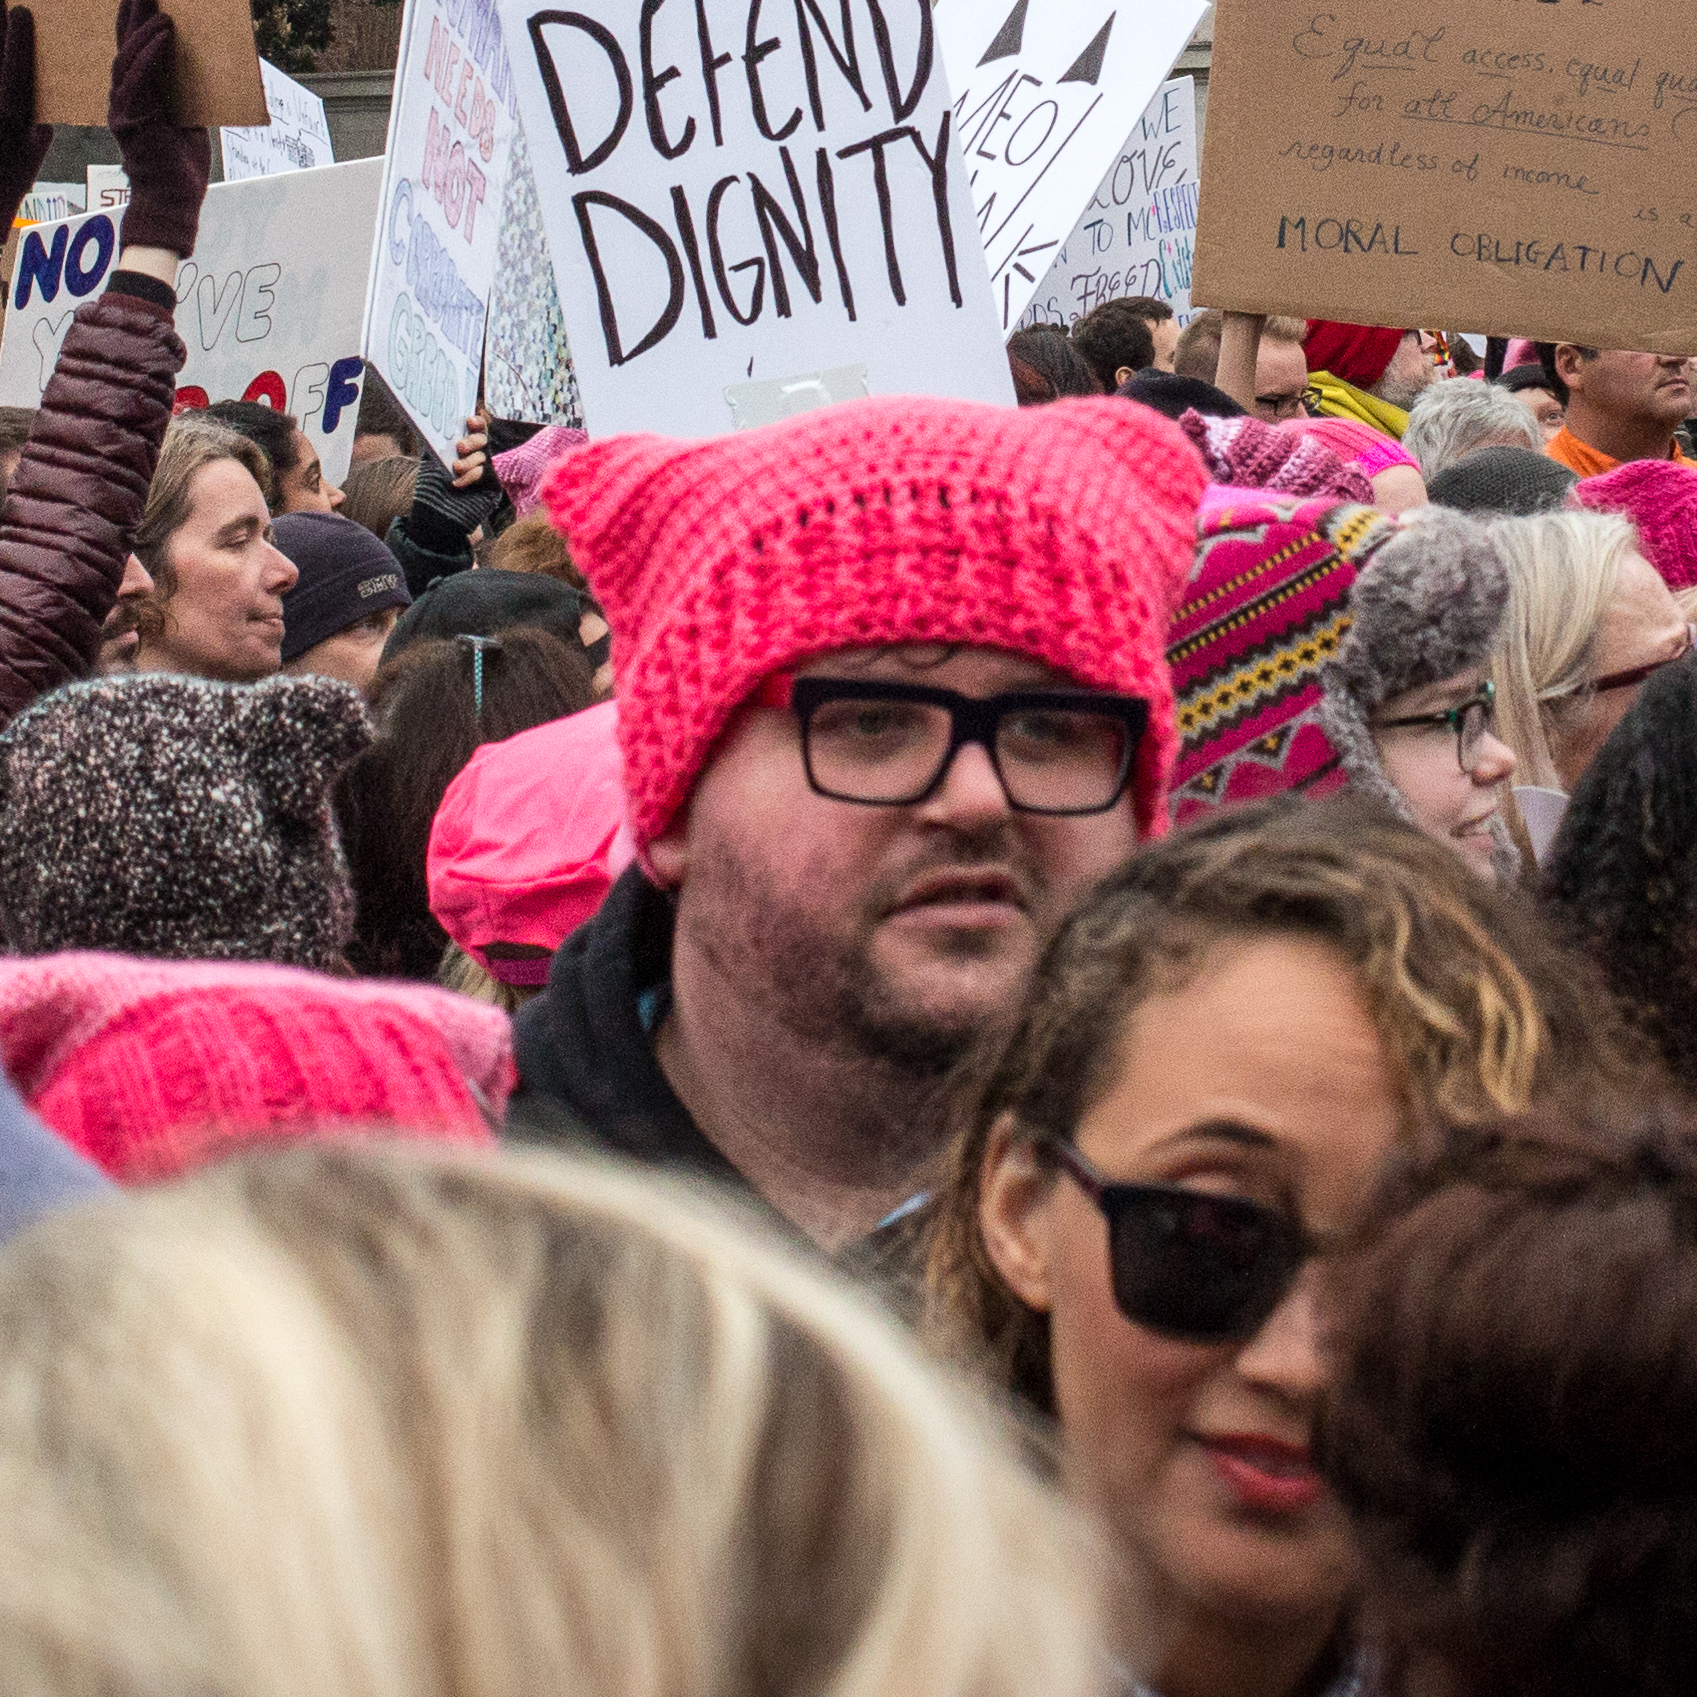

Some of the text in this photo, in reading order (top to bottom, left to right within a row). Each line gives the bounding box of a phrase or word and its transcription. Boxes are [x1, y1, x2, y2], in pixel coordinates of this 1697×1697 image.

[423, 15, 496, 162] NEEDS
[1292, 14, 1446, 83] Equal
[1565, 58, 1640, 96] equal
[1142, 87, 1181, 141] WE
[1404, 91, 1456, 119] all
[1472, 90, 1651, 139] Americans
[421, 105, 486, 245] NOT
[1278, 140, 1600, 195] regardless of income
[571, 110, 963, 367] DIGNITY
[1084, 218, 1113, 256] TO
[1276, 215, 1685, 294] MORAL OBLIGATION
[1679, 210, 1696, 229] a
[14, 214, 115, 311] NO
[388, 291, 459, 440] GREED
